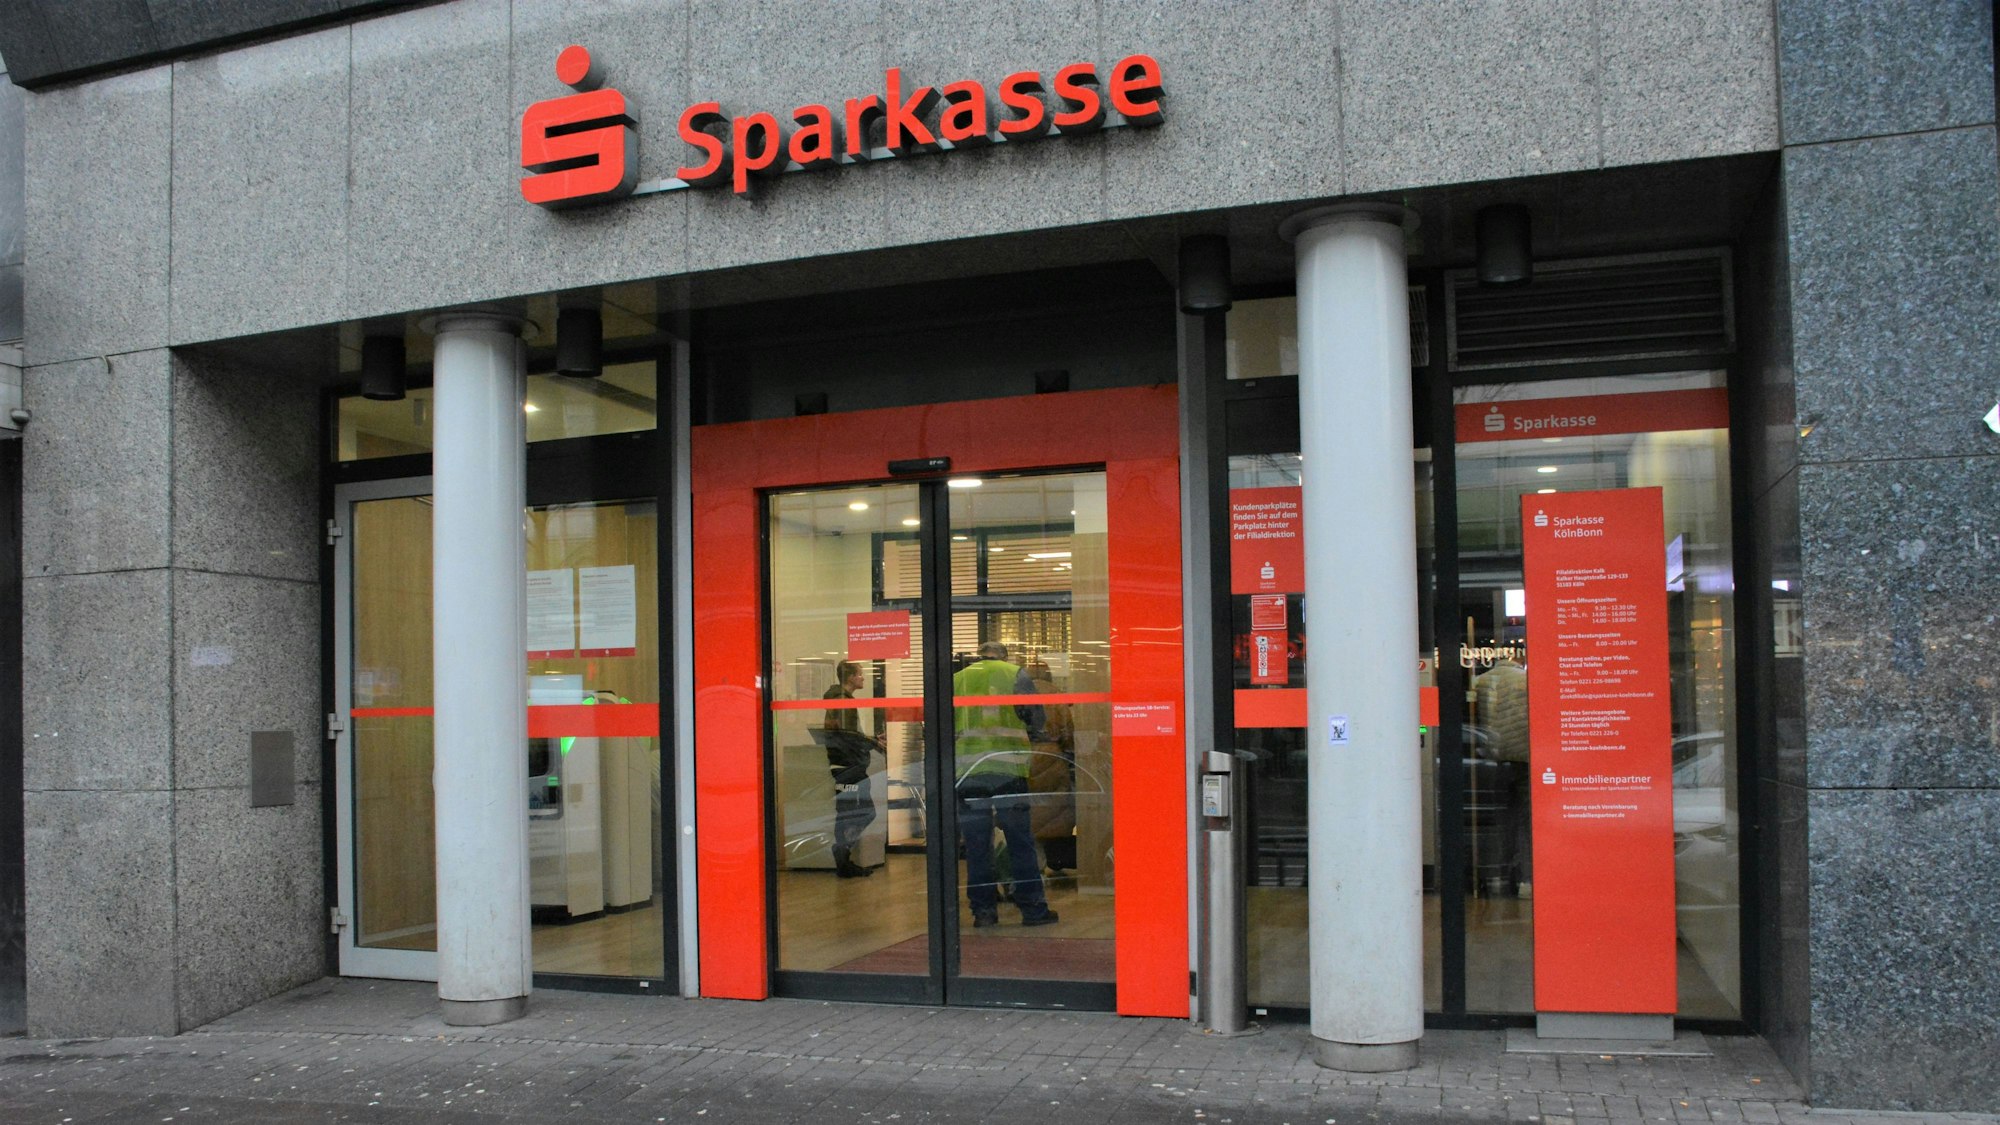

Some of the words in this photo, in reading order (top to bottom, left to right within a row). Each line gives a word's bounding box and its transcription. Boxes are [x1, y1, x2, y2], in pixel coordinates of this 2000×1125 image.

[676, 54, 1163, 194] Sparkasse
[1513, 414, 1597, 432] Sparkasse
[1233, 502, 1296, 512] Kundenparkplätze
[1234, 521, 1266, 530] Parkplatz
[1553, 516, 1604, 526] Sparkasse
[1247, 531, 1295, 539] Filialdirektion
[1554, 529, 1602, 538] KölnBonn
[1562, 775, 1651, 785] Immobilienpartner
